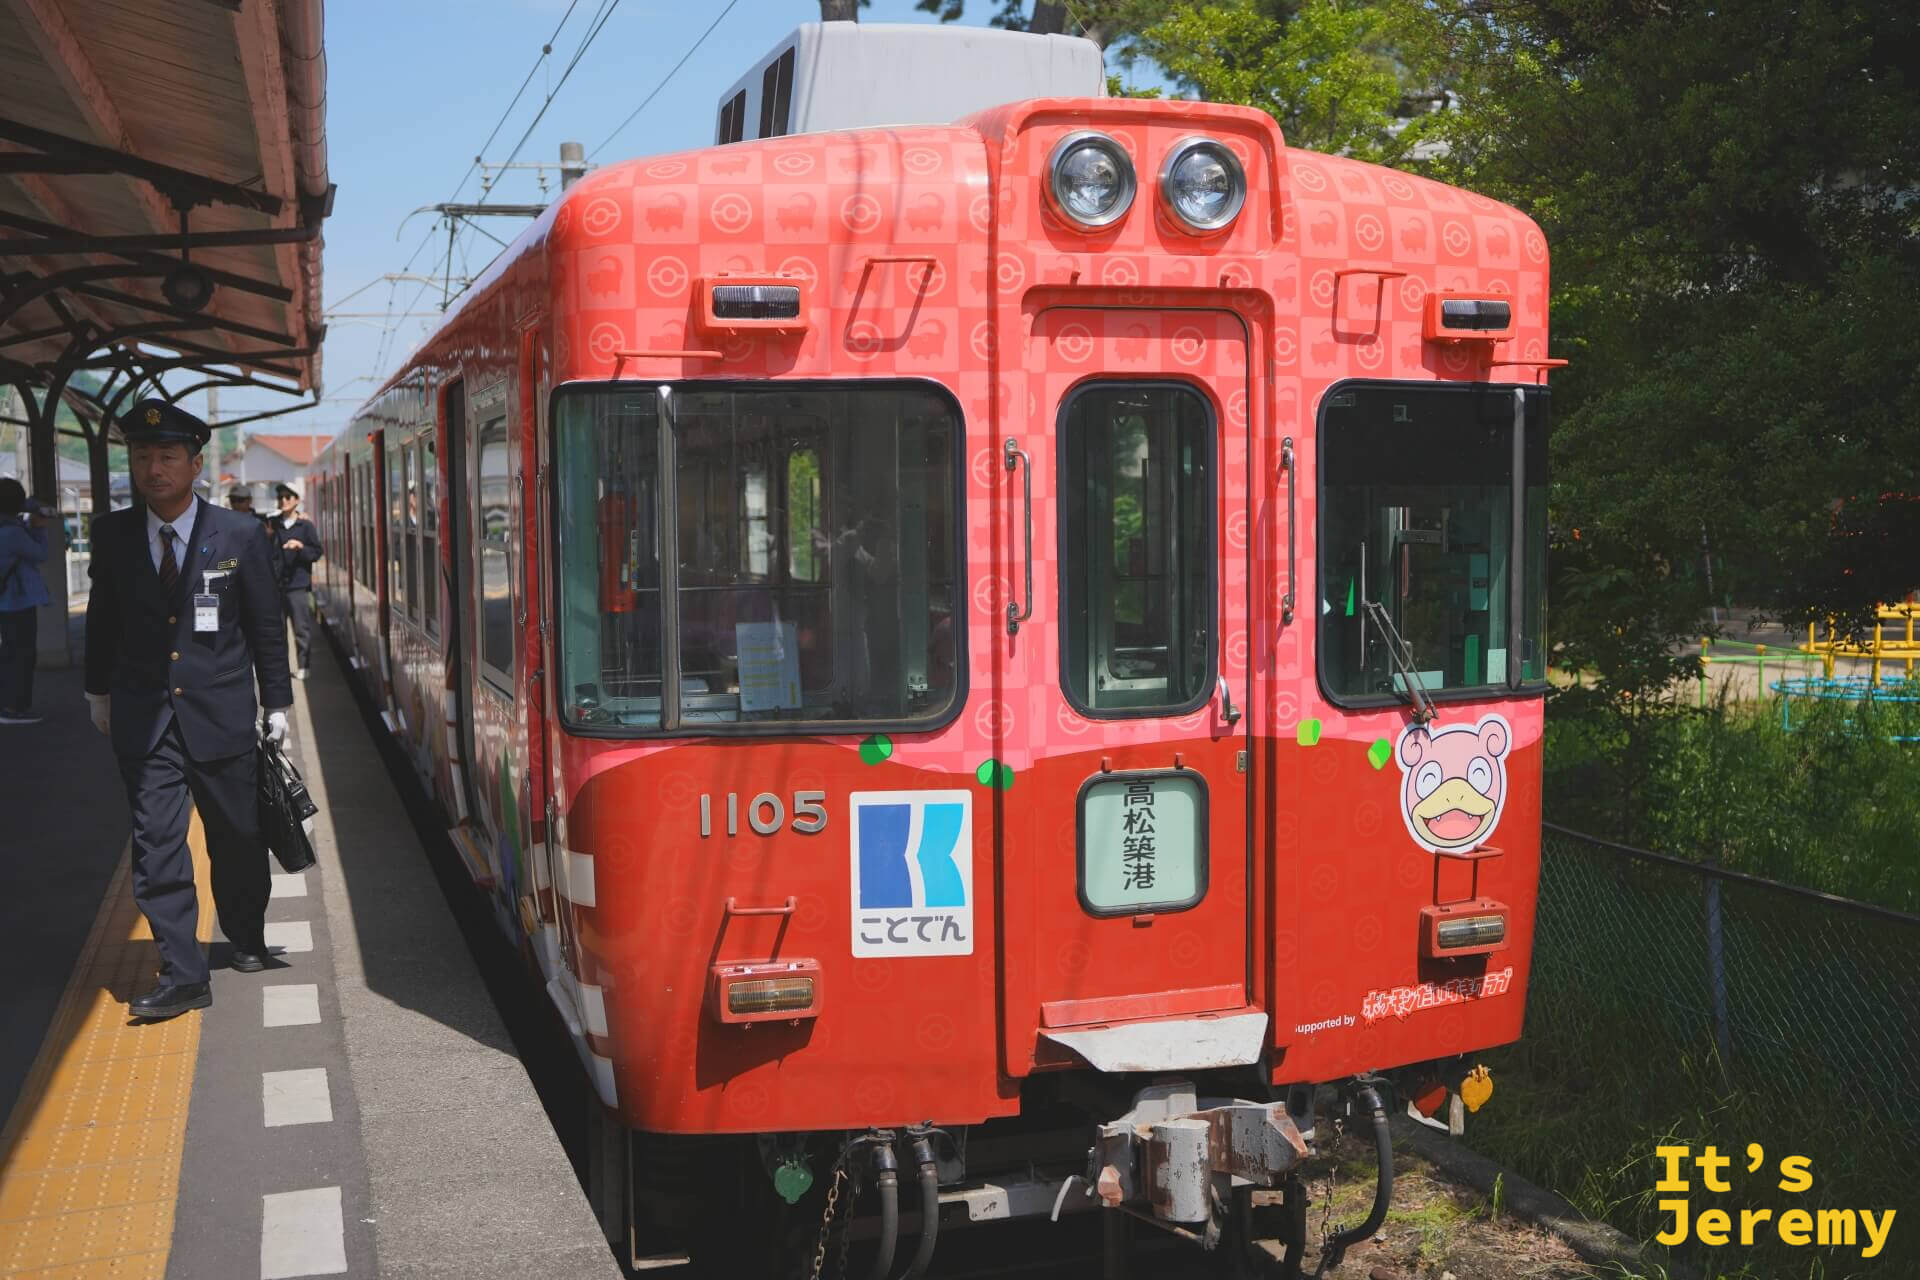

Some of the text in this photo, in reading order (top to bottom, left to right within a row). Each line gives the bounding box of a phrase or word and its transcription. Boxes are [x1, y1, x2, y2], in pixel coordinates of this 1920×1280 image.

[701, 791, 828, 836] 1105
[1123, 777, 1155, 890] 高松築港
[861, 915, 966, 944] ことでん
[1295, 1015, 1356, 1034] upported by
